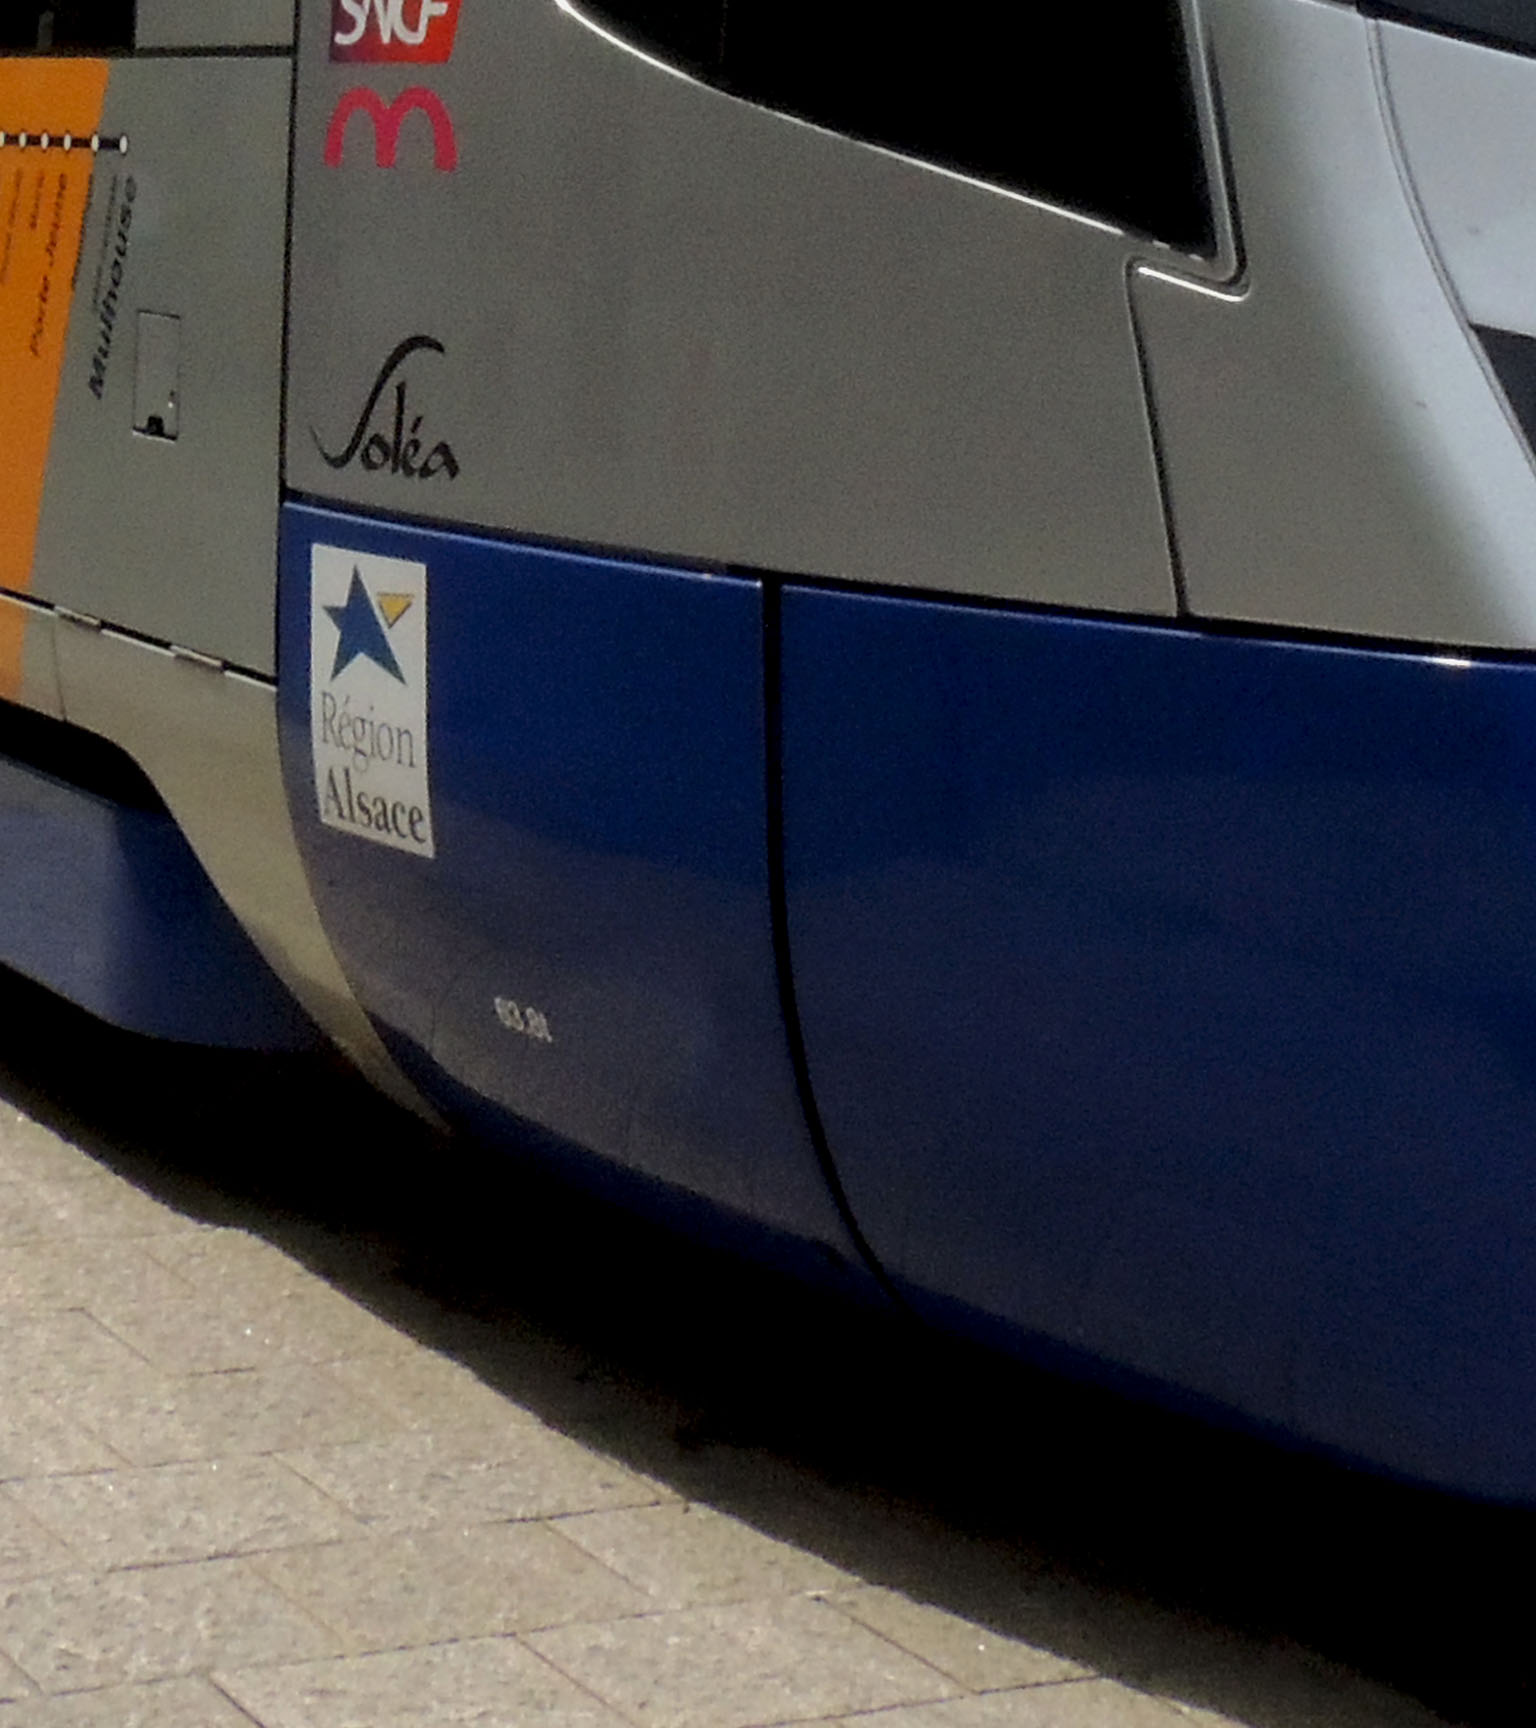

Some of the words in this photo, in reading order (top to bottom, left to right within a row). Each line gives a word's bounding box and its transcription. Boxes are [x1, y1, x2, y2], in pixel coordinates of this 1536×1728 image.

[88, 175, 137, 400] Mulhouse
[309, 334, 460, 481] Soléa
[321, 690, 417, 774] Région
[323, 766, 426, 845] Alsace
